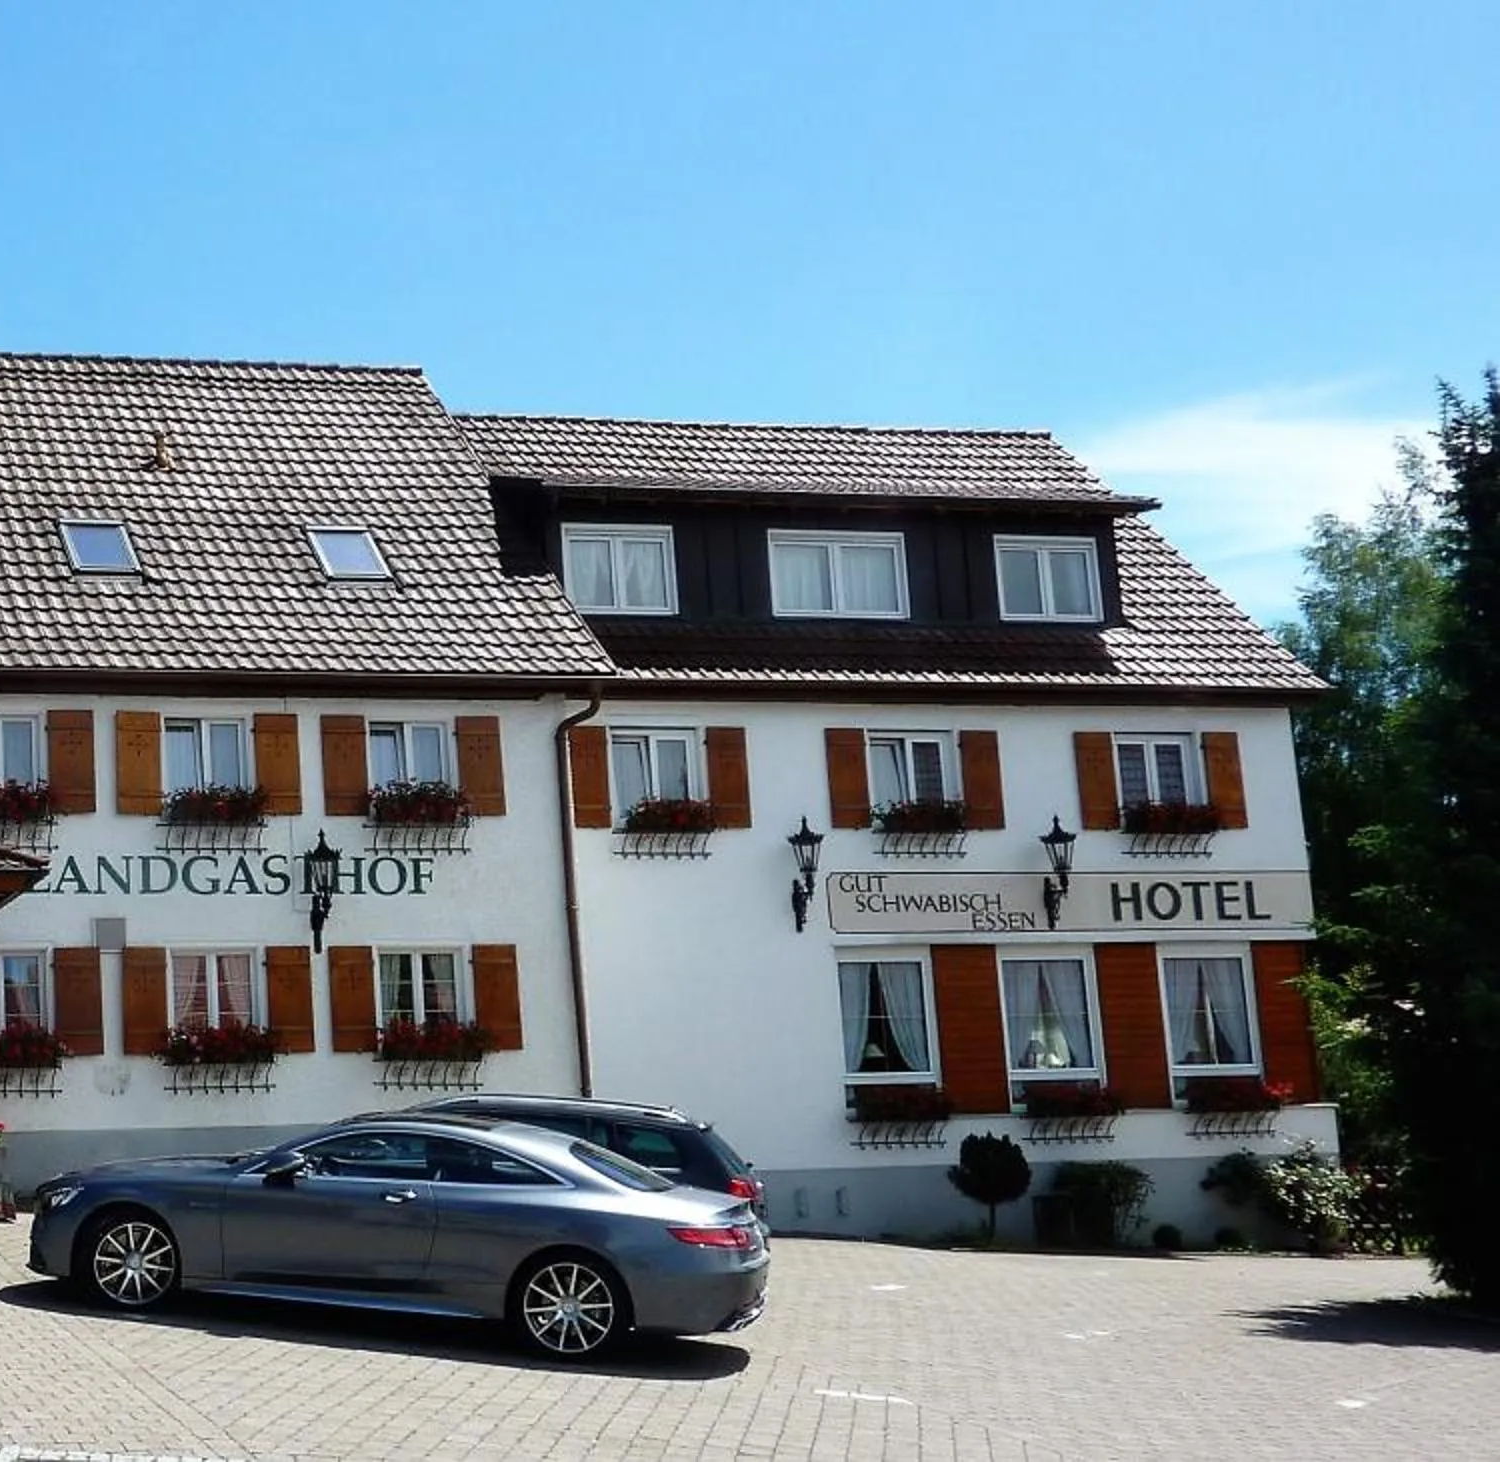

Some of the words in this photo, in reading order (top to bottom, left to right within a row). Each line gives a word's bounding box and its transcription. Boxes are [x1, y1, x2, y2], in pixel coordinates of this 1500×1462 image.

[839, 875, 888, 893] GUT
[1111, 880, 1272, 922] HOTEL
[972, 911, 1036, 930] ESSEN
